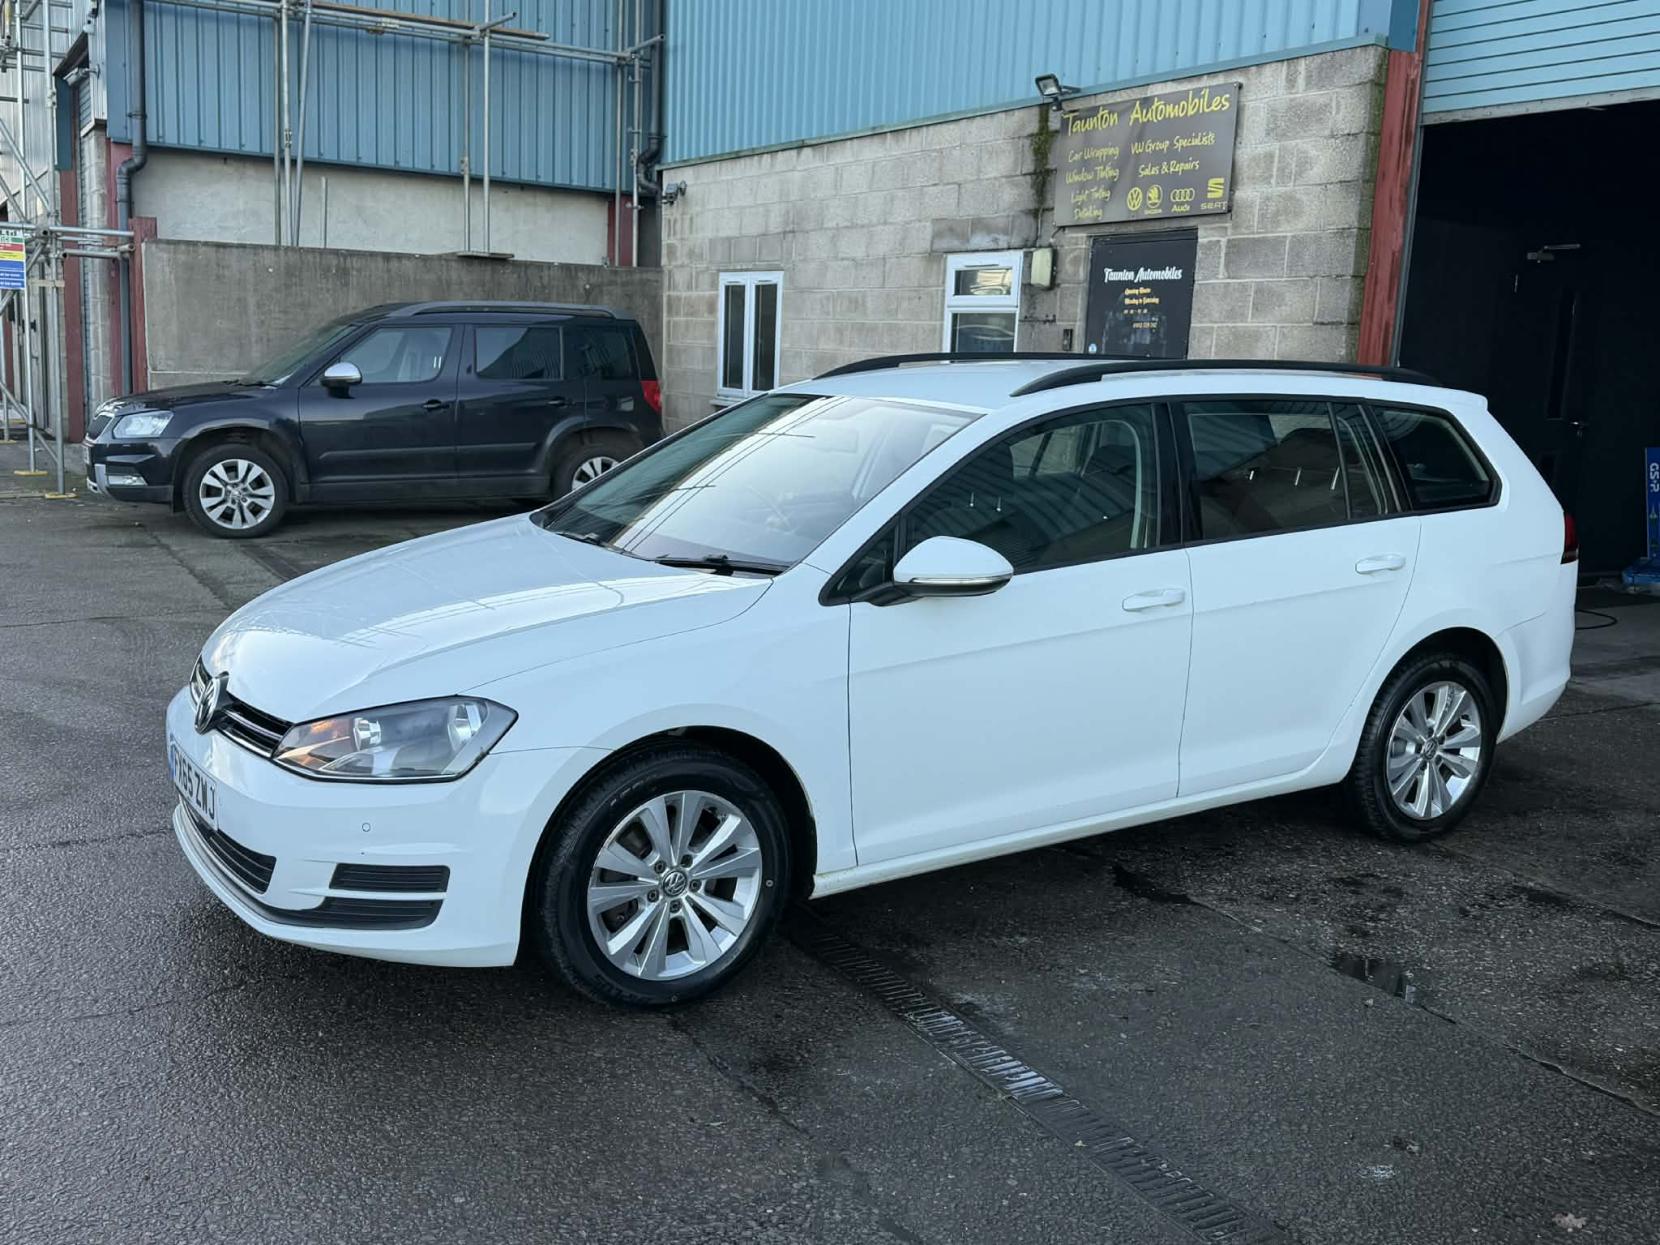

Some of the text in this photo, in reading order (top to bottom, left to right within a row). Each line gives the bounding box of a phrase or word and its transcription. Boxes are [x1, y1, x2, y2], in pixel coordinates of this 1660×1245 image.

[1061, 88, 1230, 136] Taunton Automobiles
[1146, 138, 1169, 153] Group
[1173, 132, 1216, 151] Specialists
[1084, 143, 1120, 161] Wrapping
[1139, 157, 1200, 177] Sales & Repairs
[1171, 203, 1190, 213] Audi
[1200, 201, 1228, 210] SEAT
[1104, 266, 1183, 283] Taunton Automobiles
